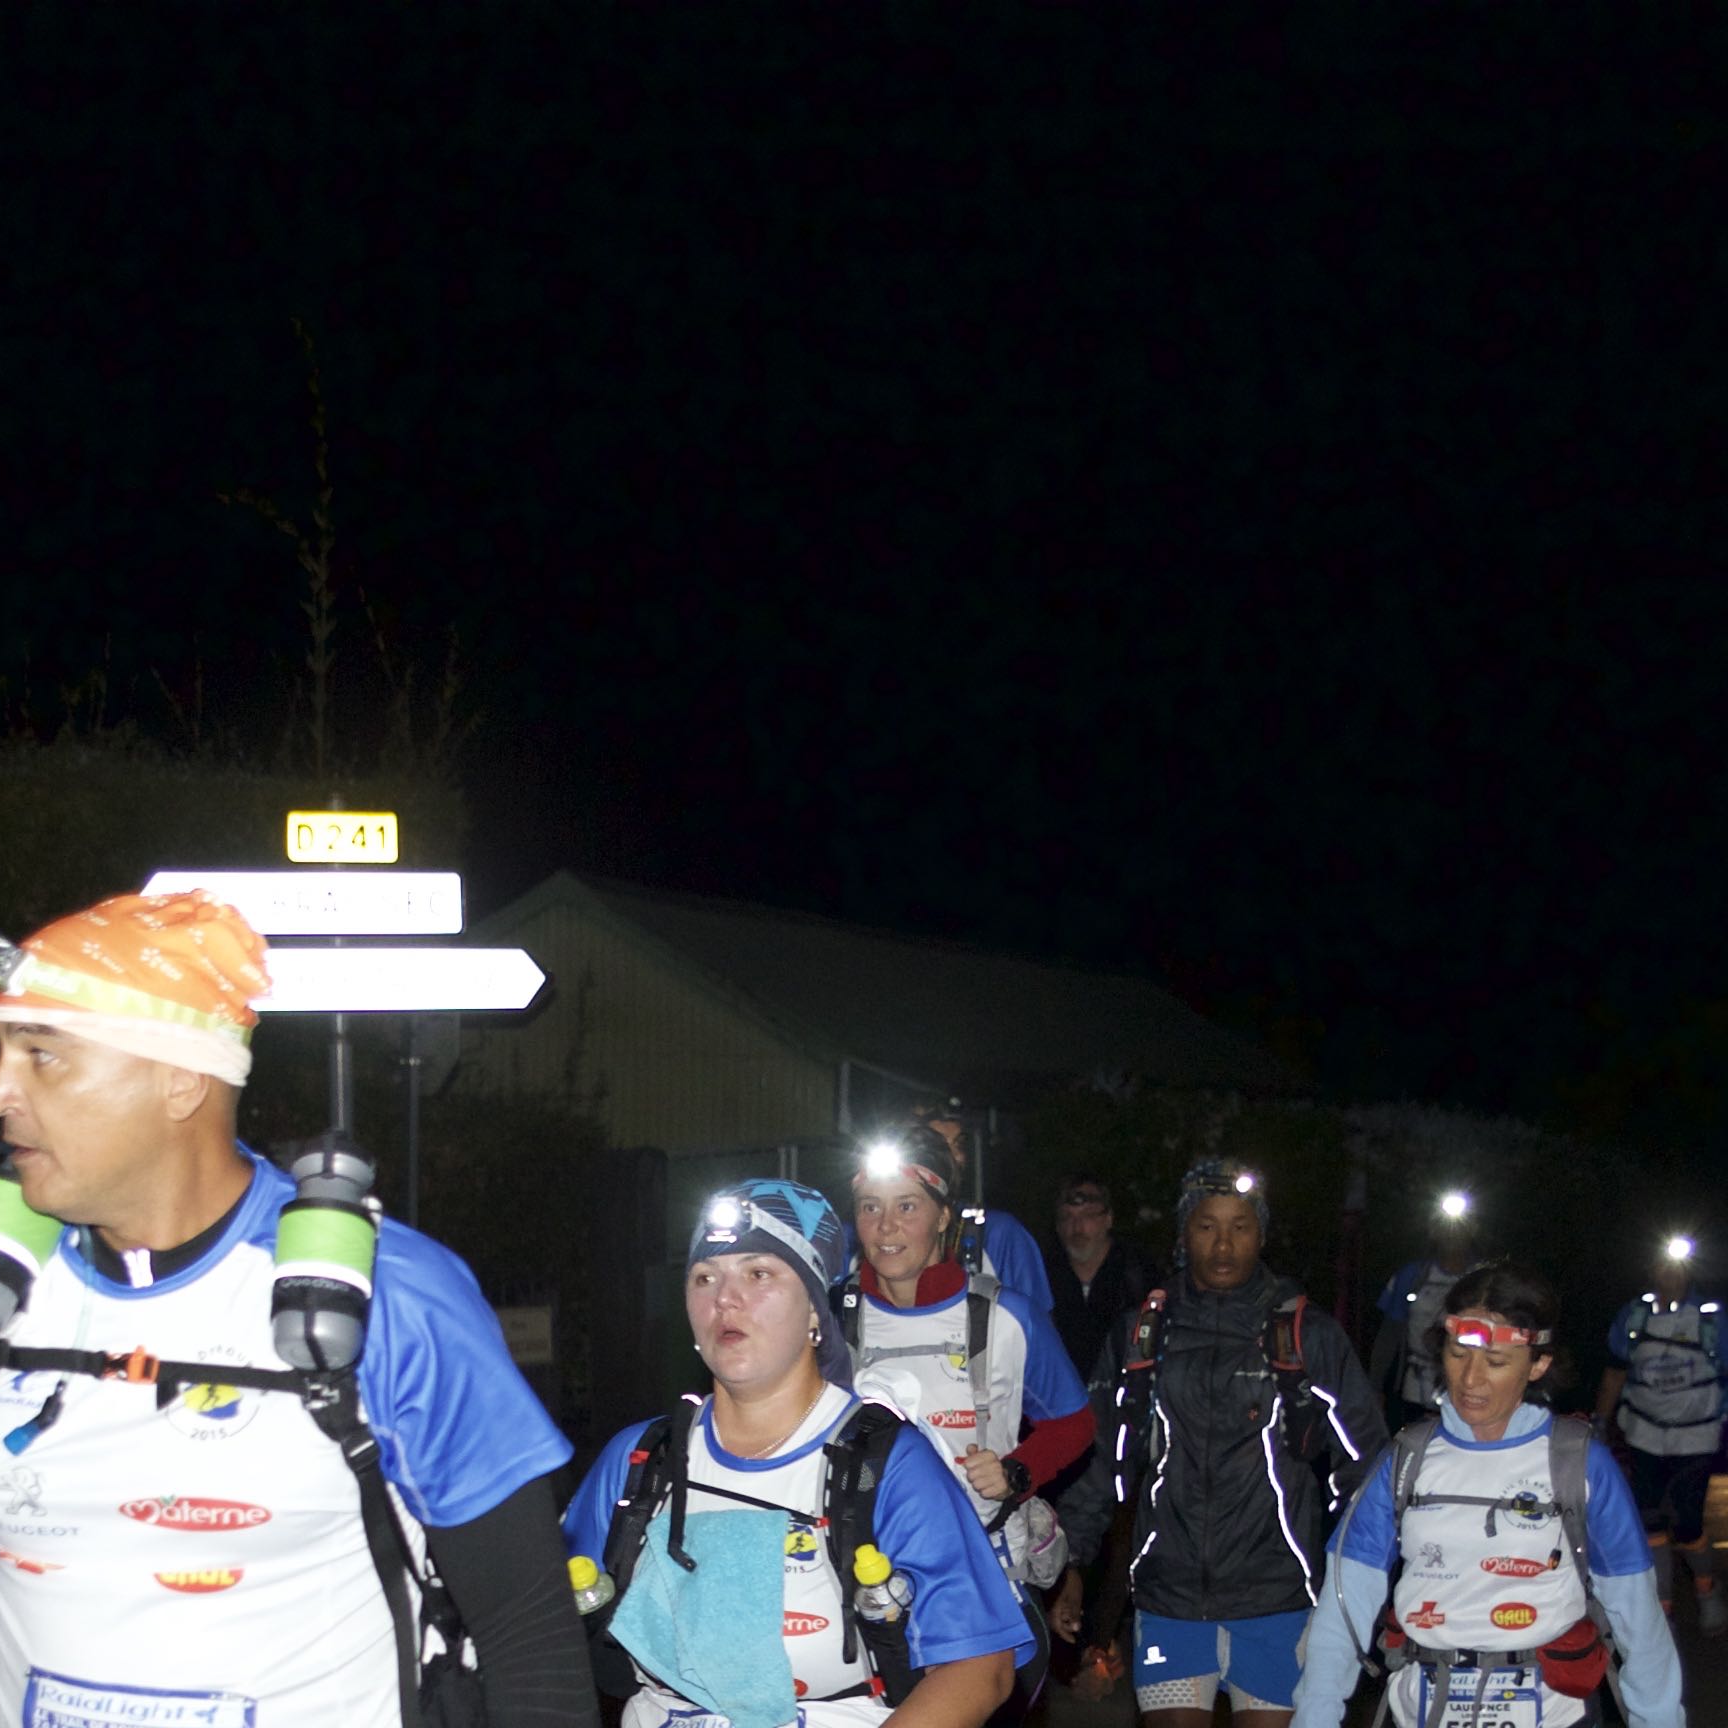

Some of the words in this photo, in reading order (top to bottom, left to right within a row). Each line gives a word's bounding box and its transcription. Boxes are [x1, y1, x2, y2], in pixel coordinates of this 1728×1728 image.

[190, 1426, 228, 1442] 2015
[122, 1498, 268, 1526] Materne
[1492, 1608, 1533, 1626] GAUL
